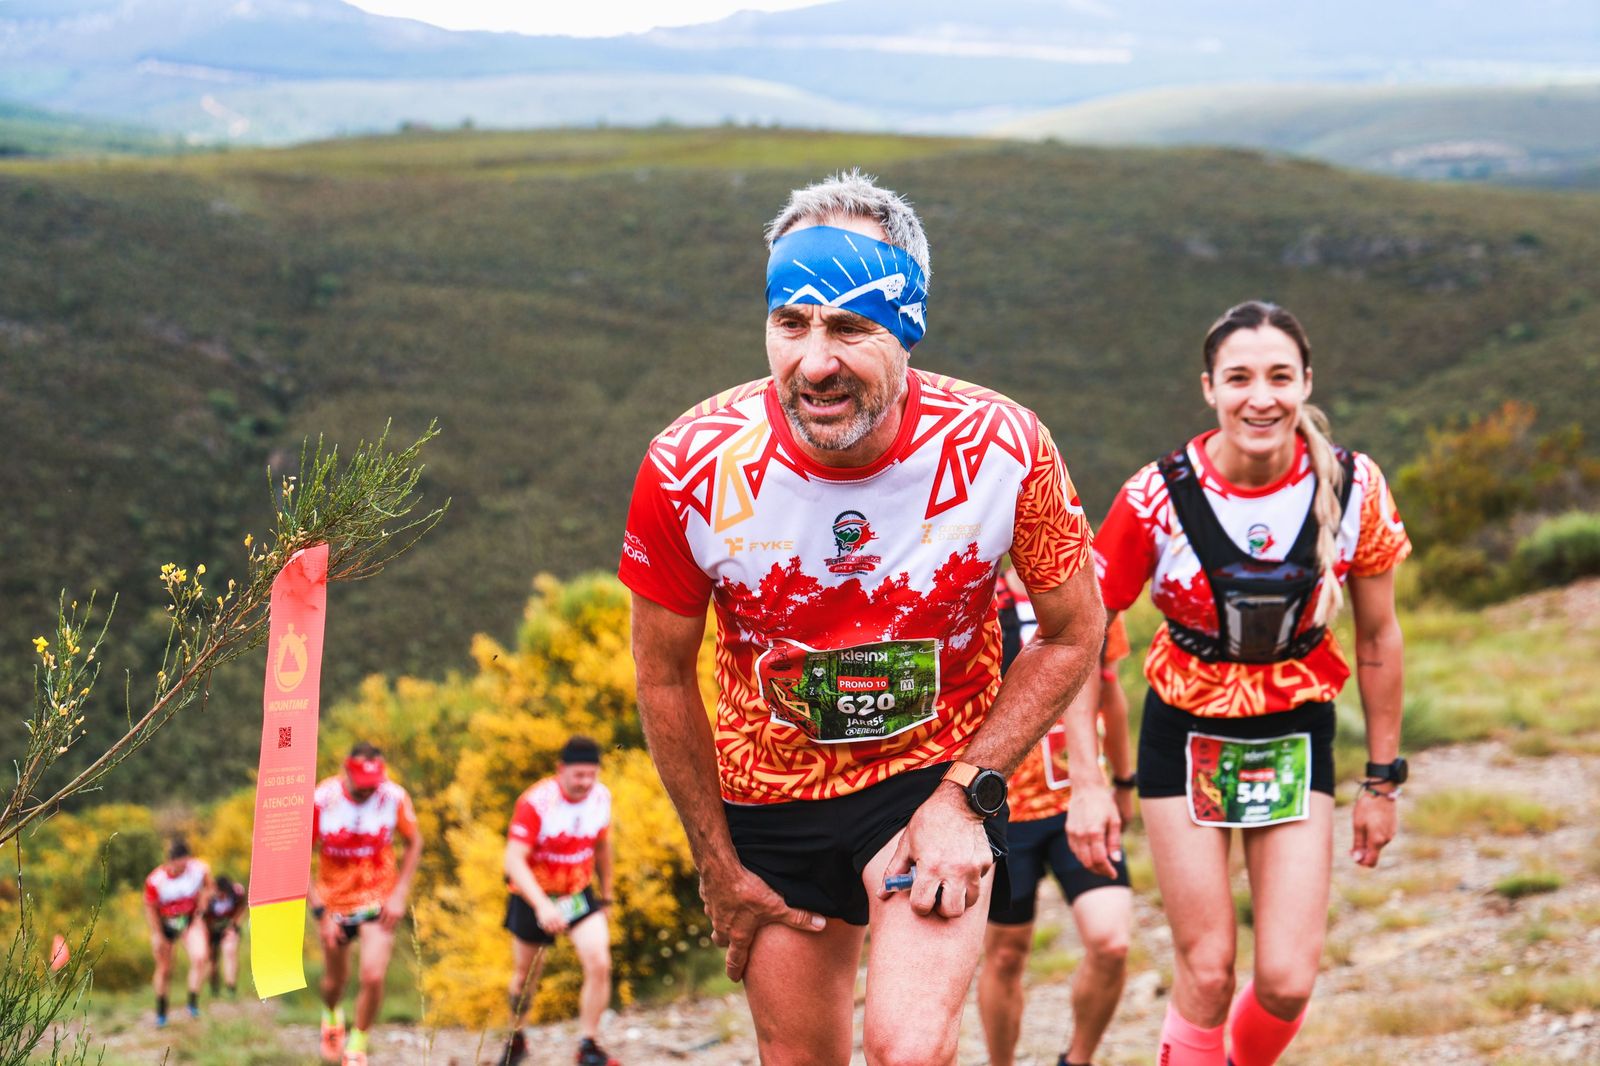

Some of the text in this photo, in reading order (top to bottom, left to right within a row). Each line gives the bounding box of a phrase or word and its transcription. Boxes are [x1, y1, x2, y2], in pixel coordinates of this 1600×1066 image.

[749, 540, 793, 552] FYKE
[839, 680, 887, 689] PROMO 10
[269, 699, 309, 712] MOUNTIME
[837, 693, 896, 716] 620
[846, 714, 884, 728] JARRSE
[1236, 782, 1281, 804] 544
[263, 793, 305, 809] ATENCIÓN
